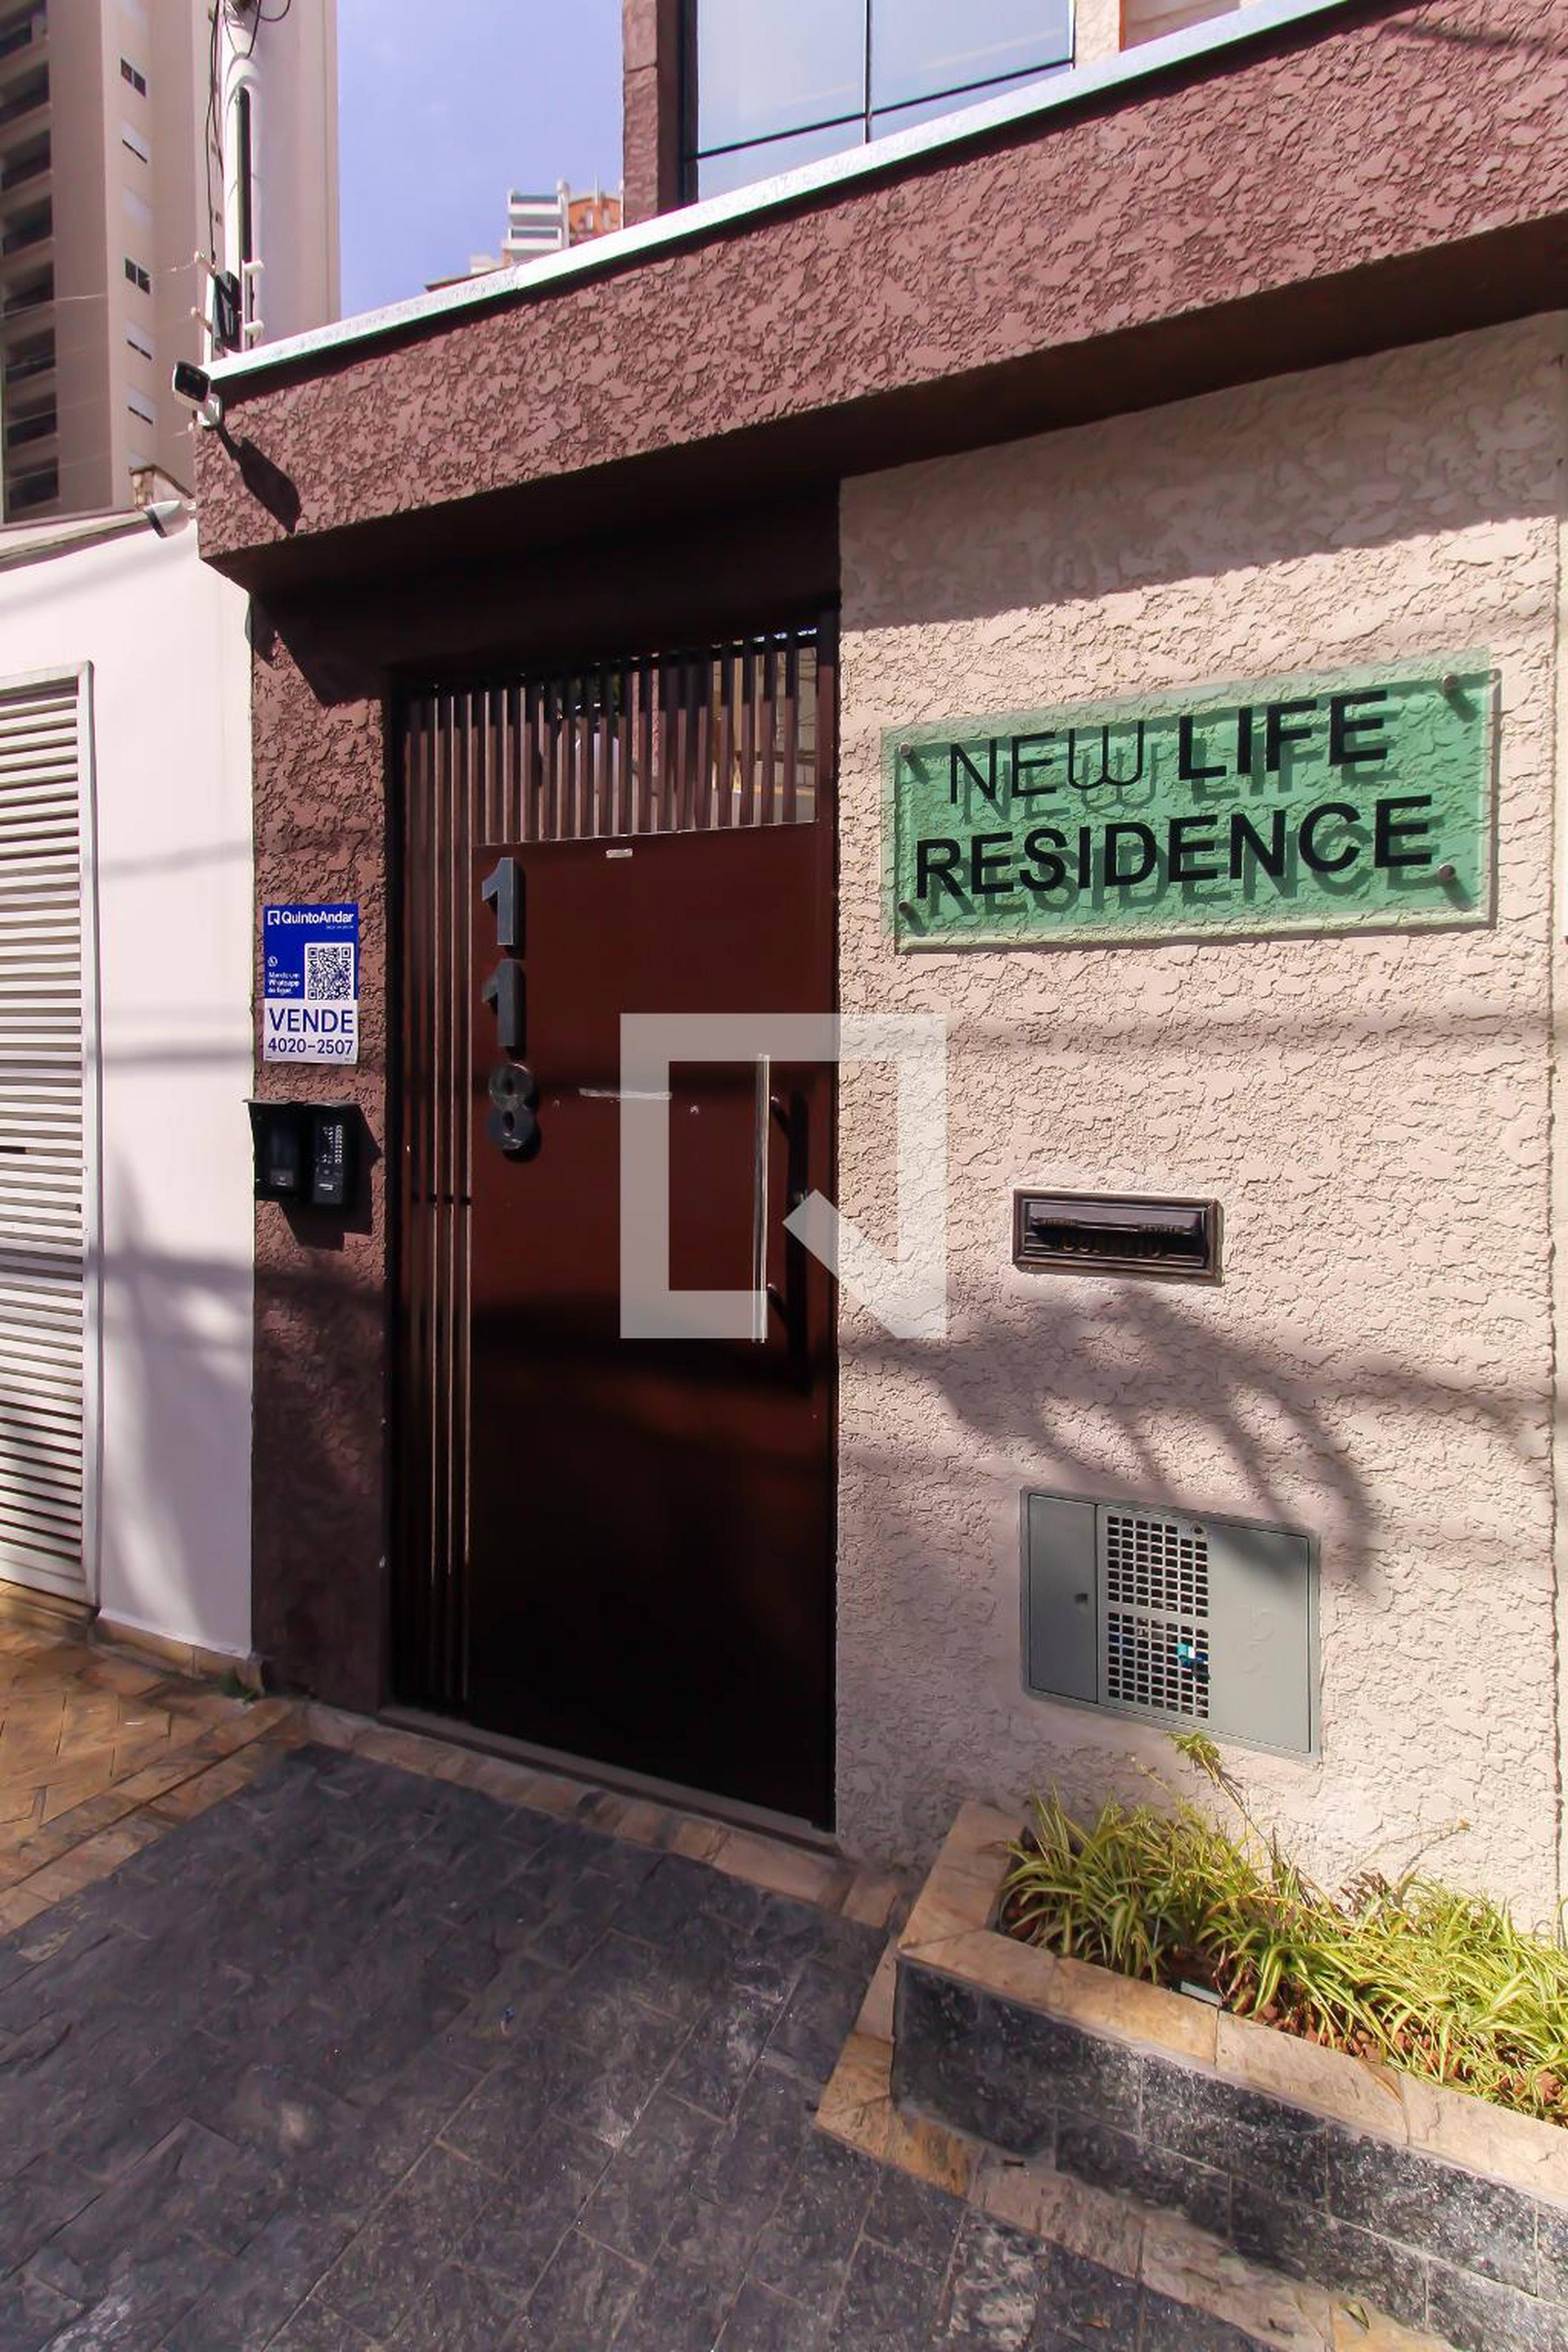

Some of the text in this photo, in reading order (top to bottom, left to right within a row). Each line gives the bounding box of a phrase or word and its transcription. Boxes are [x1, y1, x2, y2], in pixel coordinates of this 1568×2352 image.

[950, 690, 1388, 804] NEW LIFE
[916, 795, 1432, 898] RESIDENCE
[281, 911, 354, 924] QuintoAndar
[269, 1008, 354, 1034] VENDE
[482, 857, 536, 1150] 118
[268, 1038, 354, 1055] 4020-2507
